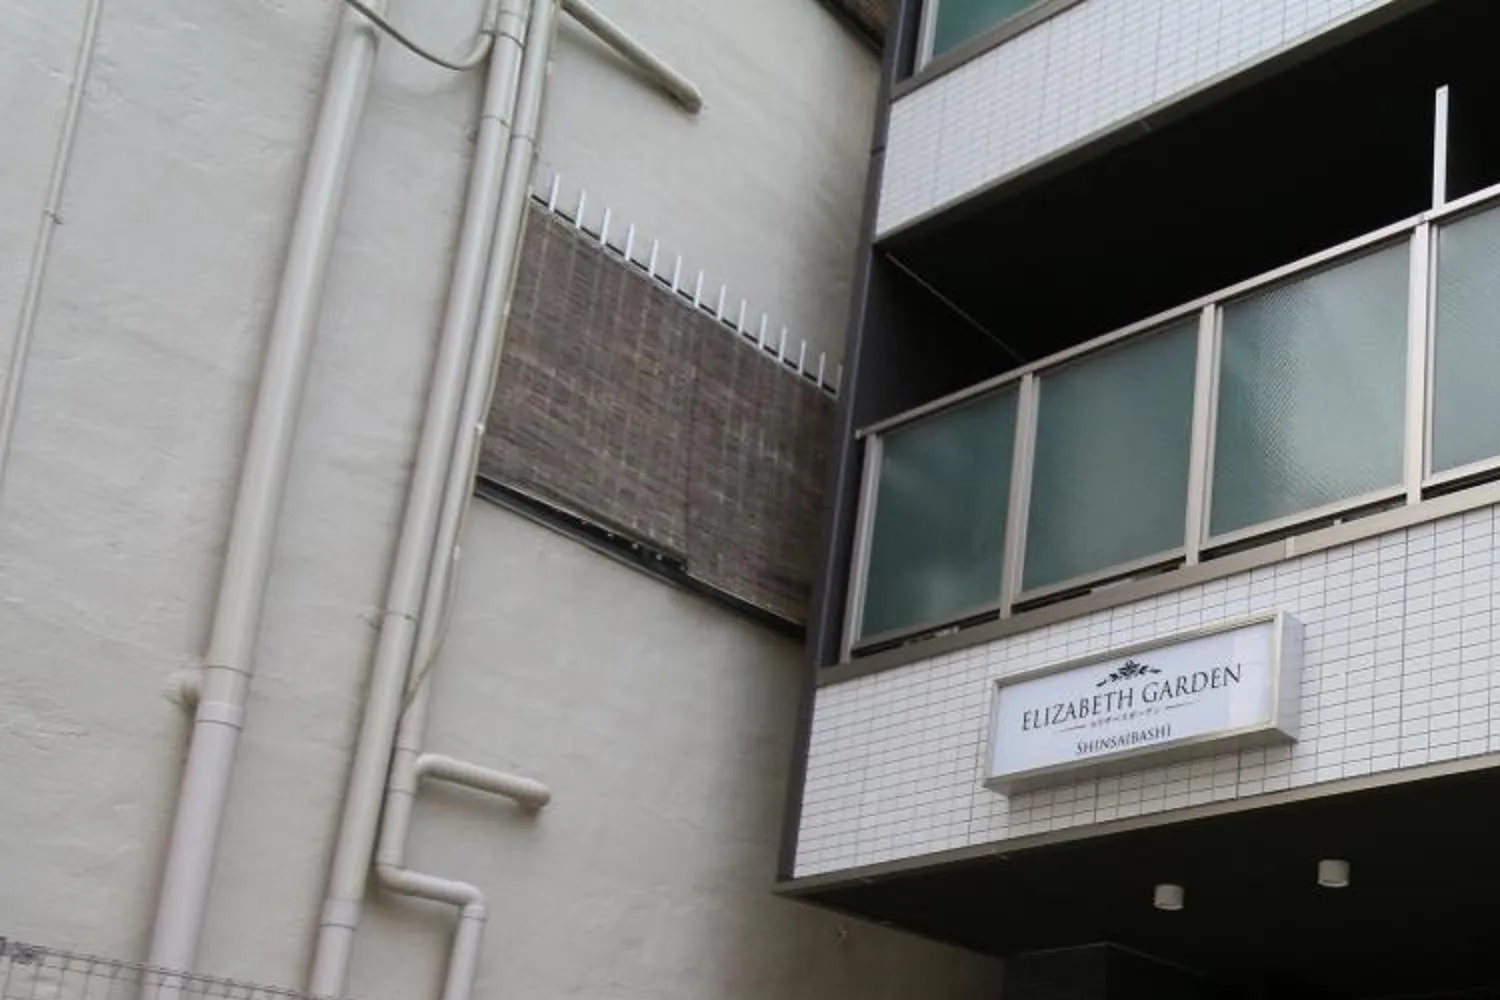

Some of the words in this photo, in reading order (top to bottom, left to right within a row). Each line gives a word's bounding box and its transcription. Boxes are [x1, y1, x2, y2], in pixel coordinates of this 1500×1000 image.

[1021, 686, 1133, 731] ELIZABETH
[1141, 663, 1242, 703] GARDEN
[1076, 724, 1172, 754] SHINSAIBASHI
